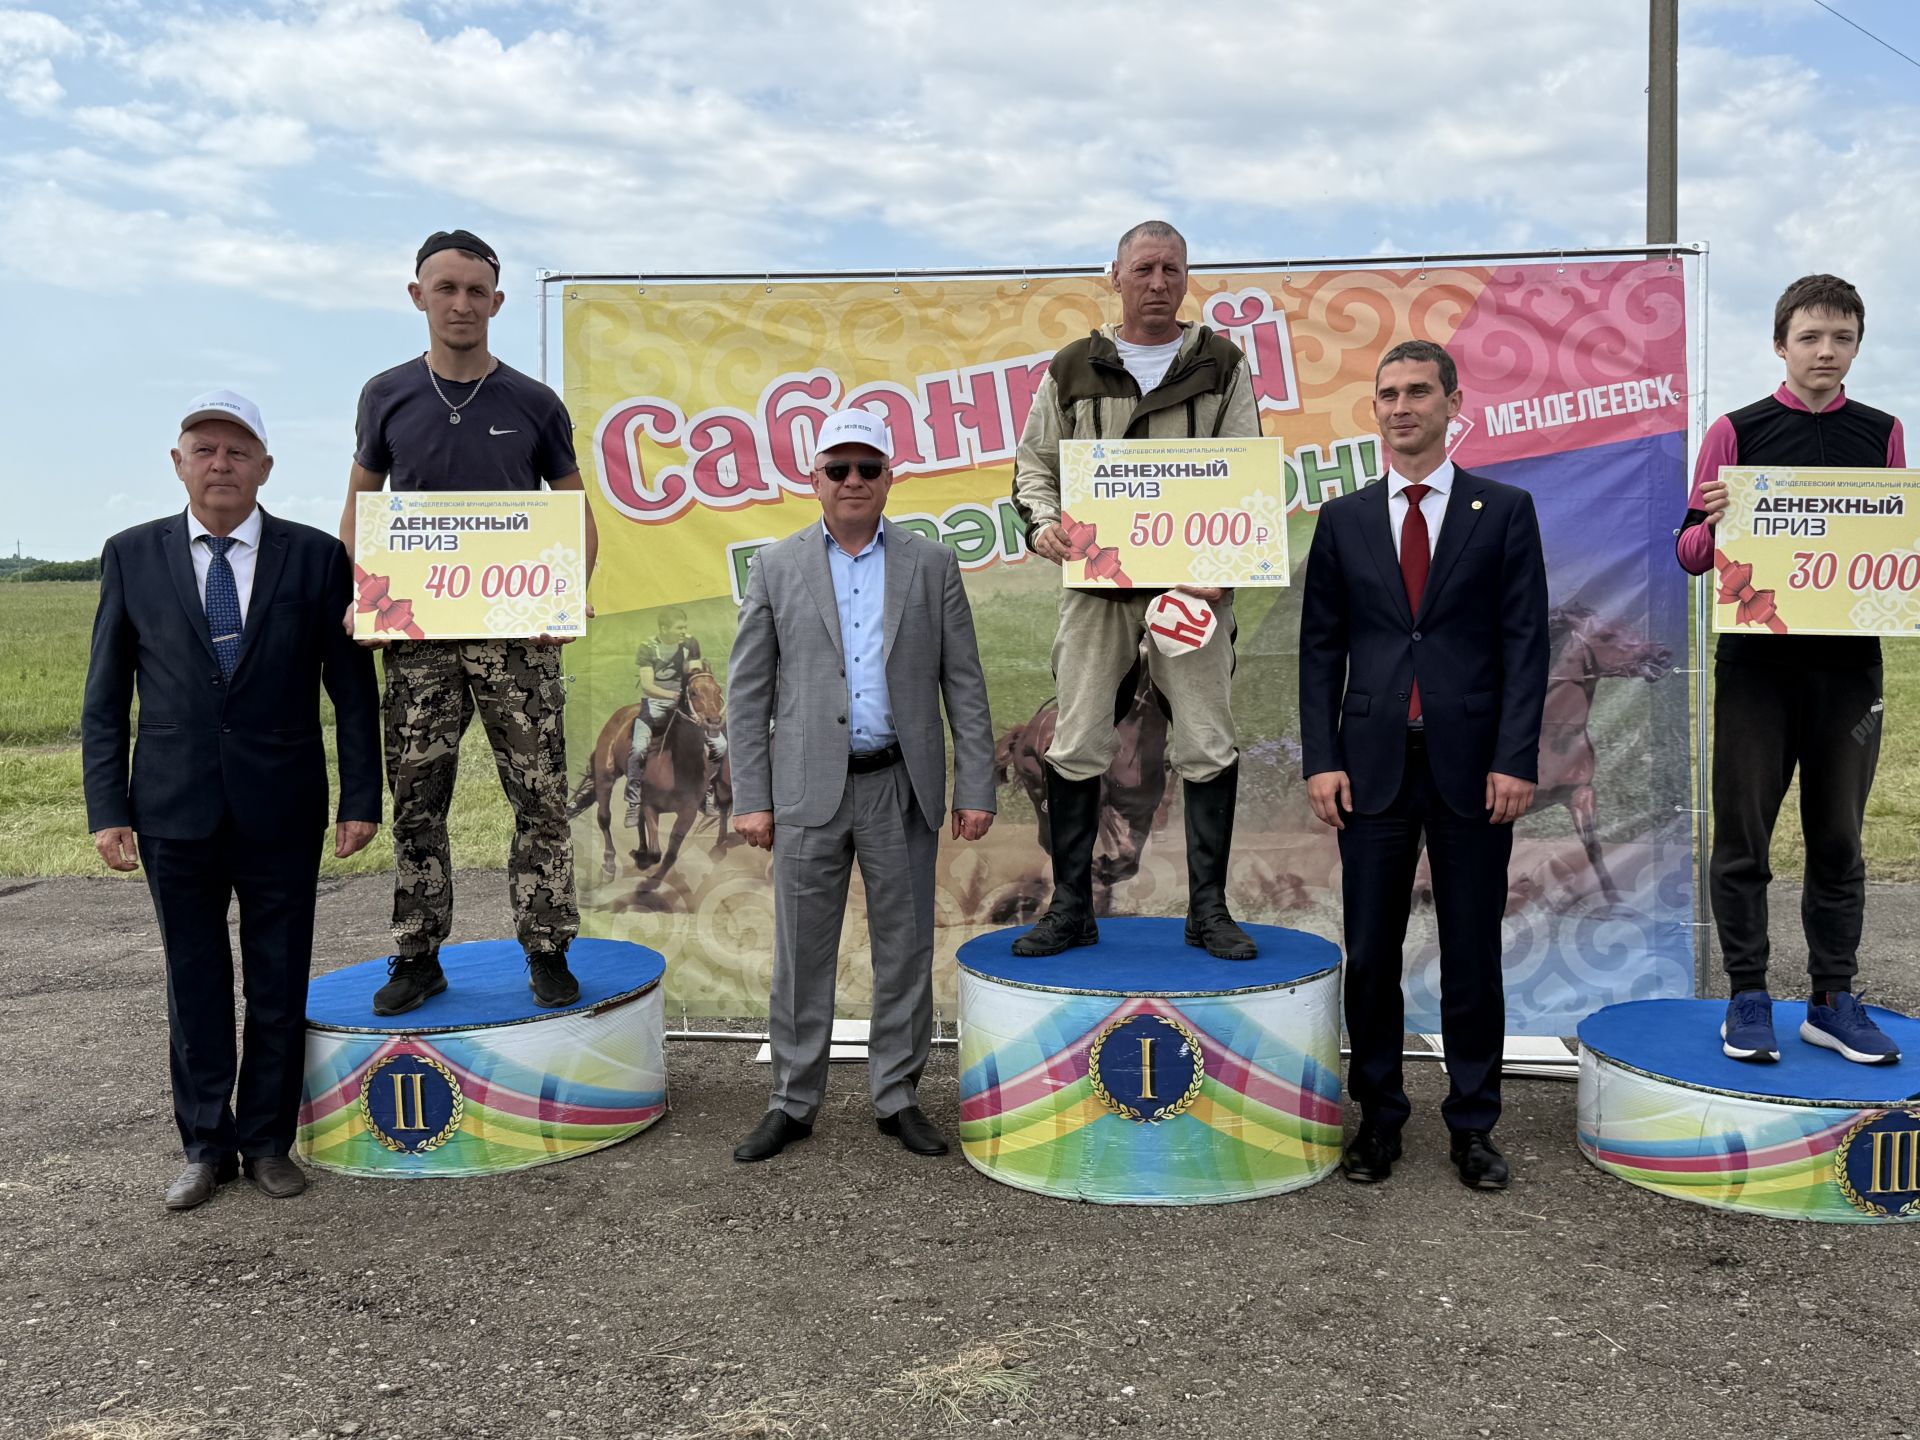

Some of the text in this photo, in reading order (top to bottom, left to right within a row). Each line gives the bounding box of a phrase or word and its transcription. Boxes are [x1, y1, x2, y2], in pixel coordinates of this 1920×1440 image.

[599, 293, 1292, 514] Сабанй
[1484, 374, 1679, 437] МЕНДЕЛЕЕВСК
[1110, 447, 1166, 455] МЕНДЕЛЕЕВСКИЙ
[1166, 446, 1225, 454] МУНИЦИПАЛЬНЫЙ
[1093, 460, 1228, 478] ДЕНЕЖНЫЙ
[1094, 482, 1161, 498] ПРИЗ
[1775, 480, 1836, 488] МЕНДЕЛЕЕВСКИЙ
[1836, 481, 1901, 489] МУНИЦИПАЛЬНЫЙ
[466, 500, 526, 508] МУНИЦИПАЛЬНЫЙ
[1753, 495, 1904, 514] ДЕНЕЖНЫЙ
[389, 513, 529, 531] ДЕНЕЖНЫЙ
[1129, 512, 1174, 546] 50
[1184, 511, 1252, 546] 000
[1753, 517, 1826, 536] ПРИЗ
[389, 534, 459, 551] ПРИЗ
[1788, 552, 1920, 591] 30 000
[425, 564, 471, 599] 40
[481, 564, 550, 598] 000
[1135, 1037, 1158, 1099] I
[388, 1072, 431, 1130] II
[1865, 1129, 1920, 1193] III
